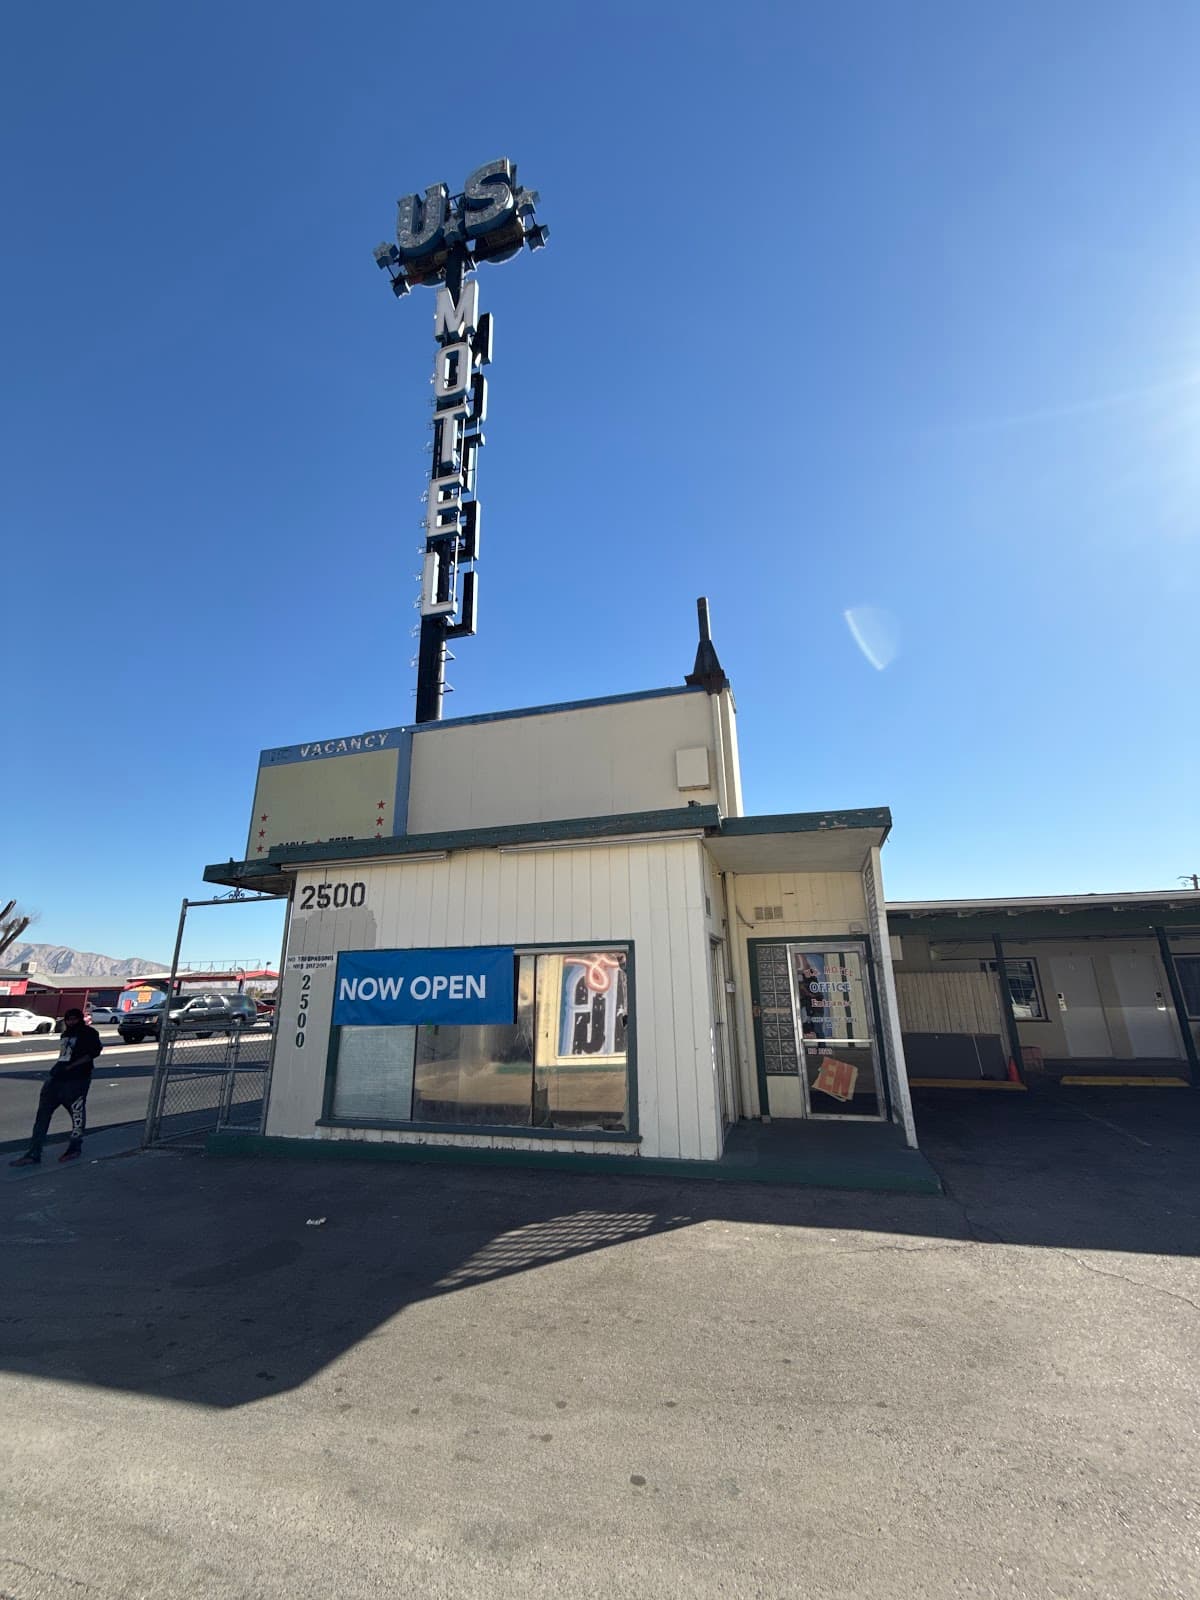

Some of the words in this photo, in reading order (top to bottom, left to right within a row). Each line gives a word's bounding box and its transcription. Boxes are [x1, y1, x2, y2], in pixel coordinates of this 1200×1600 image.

[421, 280, 479, 617] MOTEL
[300, 732, 390, 758] VACANCY
[300, 882, 366, 910] 2500
[339, 976, 404, 1001] NOW
[410, 974, 486, 1000] OPEN
[810, 982, 851, 993] OFFICE
[295, 974, 311, 1048] 2500
